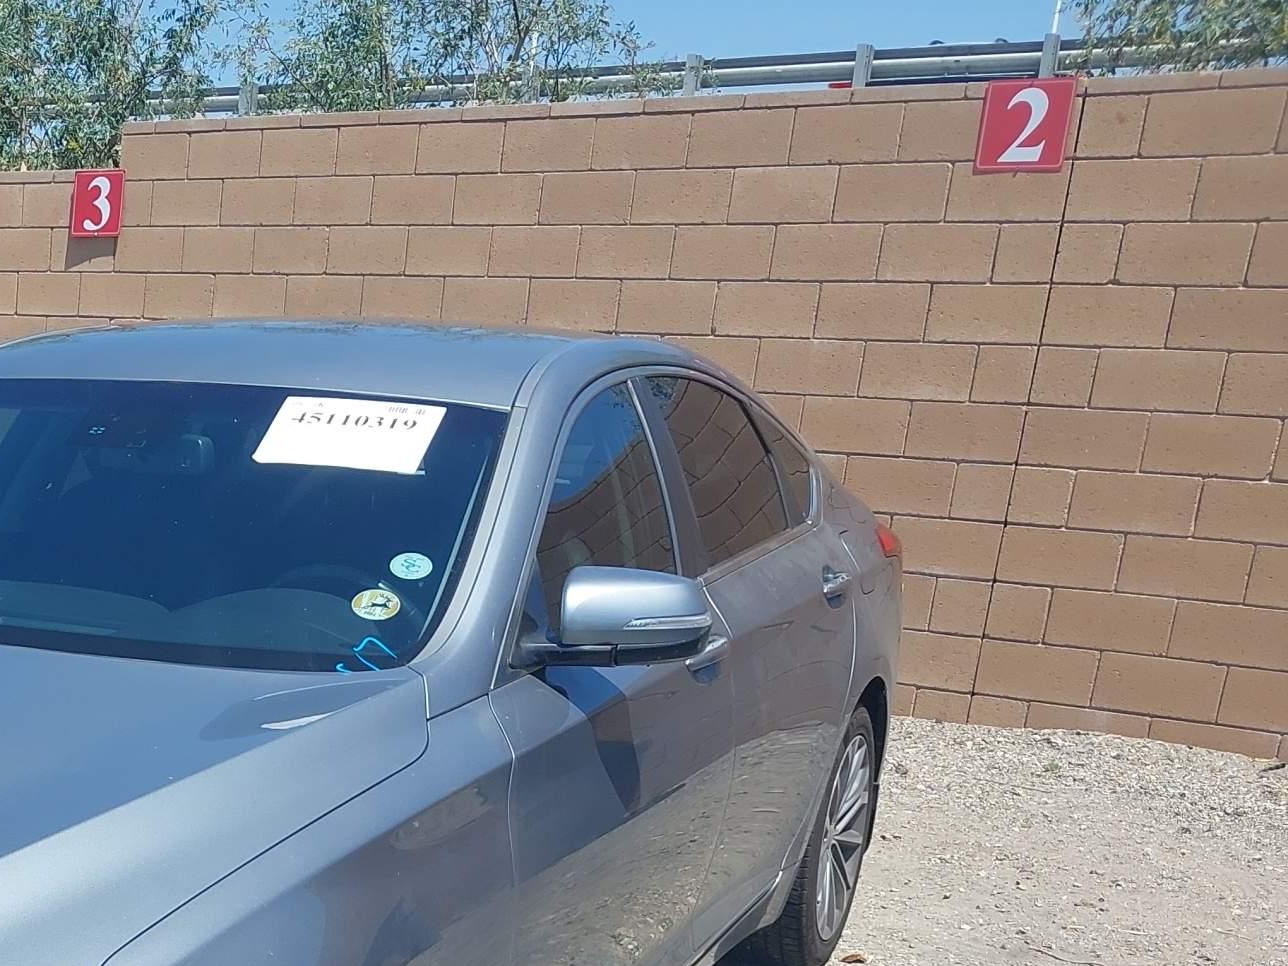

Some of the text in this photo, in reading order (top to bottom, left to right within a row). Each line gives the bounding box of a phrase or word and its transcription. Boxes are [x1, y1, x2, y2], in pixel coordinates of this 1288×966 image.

[997, 87, 1050, 162] 2
[83, 175, 111, 235] 3
[291, 411, 418, 430] 45110319
